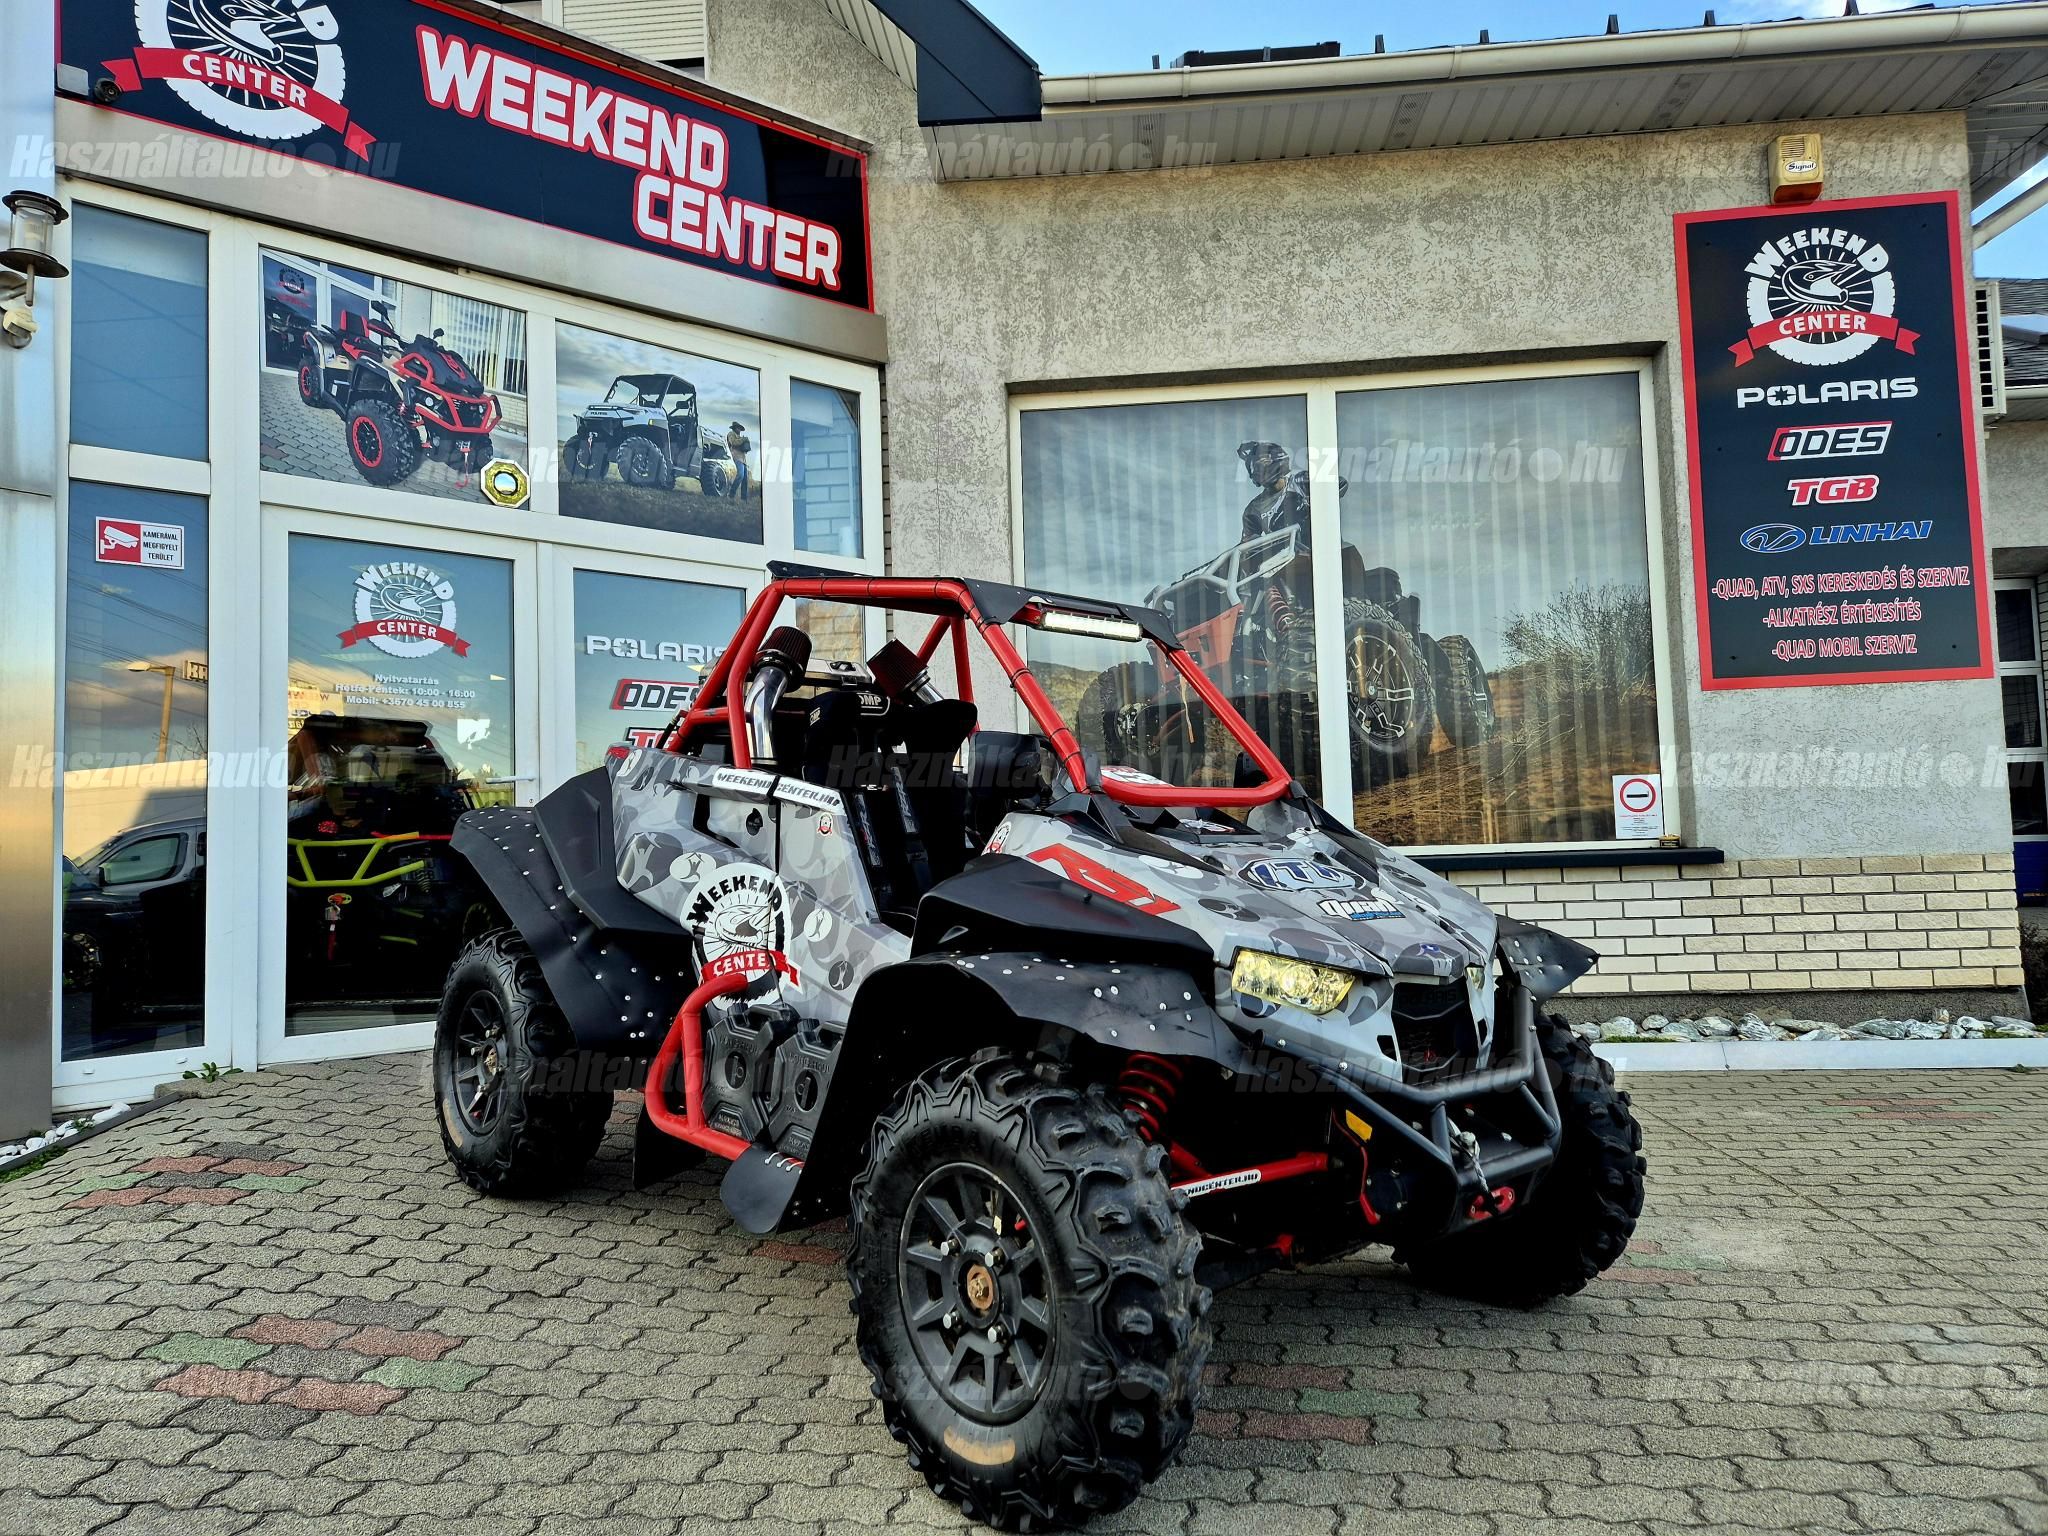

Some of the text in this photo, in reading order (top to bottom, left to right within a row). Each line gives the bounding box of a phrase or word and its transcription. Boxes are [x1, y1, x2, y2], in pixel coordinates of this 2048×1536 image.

[182, 54, 308, 108] CENTER
[420, 29, 727, 190] WEEKEND
[1788, 160, 1815, 173] Signal
[636, 175, 838, 287] CENTER
[1744, 228, 1889, 279] WEEKEND
[1779, 314, 1867, 335] CENTER
[1737, 377, 1918, 409] POLARIS
[1774, 427, 1887, 458] ODES
[1787, 475, 1879, 505] TGB
[143, 531, 178, 540] KAMERÁVAL
[143, 541, 178, 551] MEGFIGYELT
[1809, 521, 1932, 545] LINHAI
[148, 553, 174, 561] TERÜLET
[355, 562, 455, 600] WEEKEND
[1711, 564, 1970, 600] -QUAD, ATV, SXS KERESKEDÉS ÉS SZERVIZ
[1762, 598, 1922, 627] -ALKATRÉSZ ÉRTÉKESÍTÉS
[377, 621, 437, 638] CENTER
[1772, 634, 1918, 661] -QUAD MOBIL SZERVIZ
[375, 674, 439, 685] Nyitvatartás
[412, 687, 439, 696] 10:00
[346, 695, 379, 705] Mobil:
[382, 697, 413, 706] +3670
[416, 699, 429, 707] 45
[431, 700, 445, 708] 00
[686, 875, 782, 923] WEEKEND
